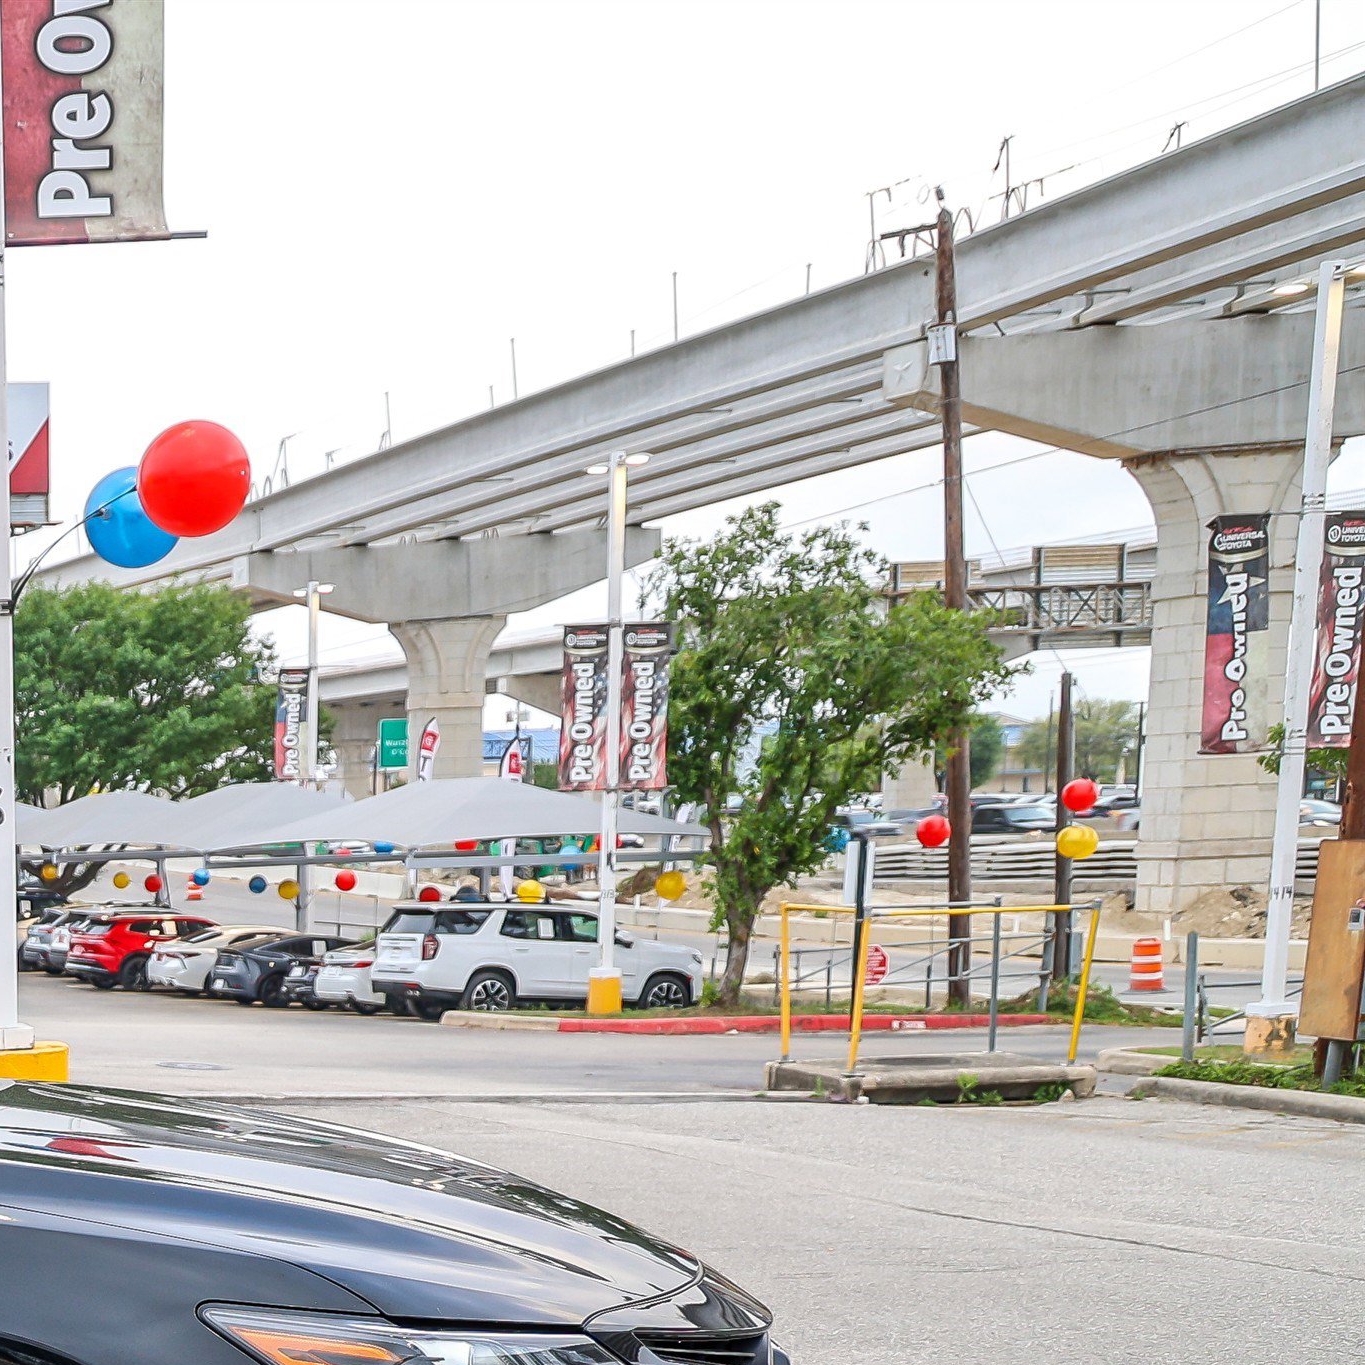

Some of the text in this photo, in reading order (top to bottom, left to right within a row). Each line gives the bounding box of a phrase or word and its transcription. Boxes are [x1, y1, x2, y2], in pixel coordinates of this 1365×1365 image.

[37, 92, 113, 218] Pre
[1324, 566, 1363, 677] Owned
[282, 693, 301, 748] Owned
[571, 662, 595, 741] Owned
[629, 661, 655, 740] Owned
[1319, 682, 1352, 738] Pre
[282, 748, 300, 776] Pre
[570, 743, 593, 782] Pre
[628, 742, 651, 781] Pre
